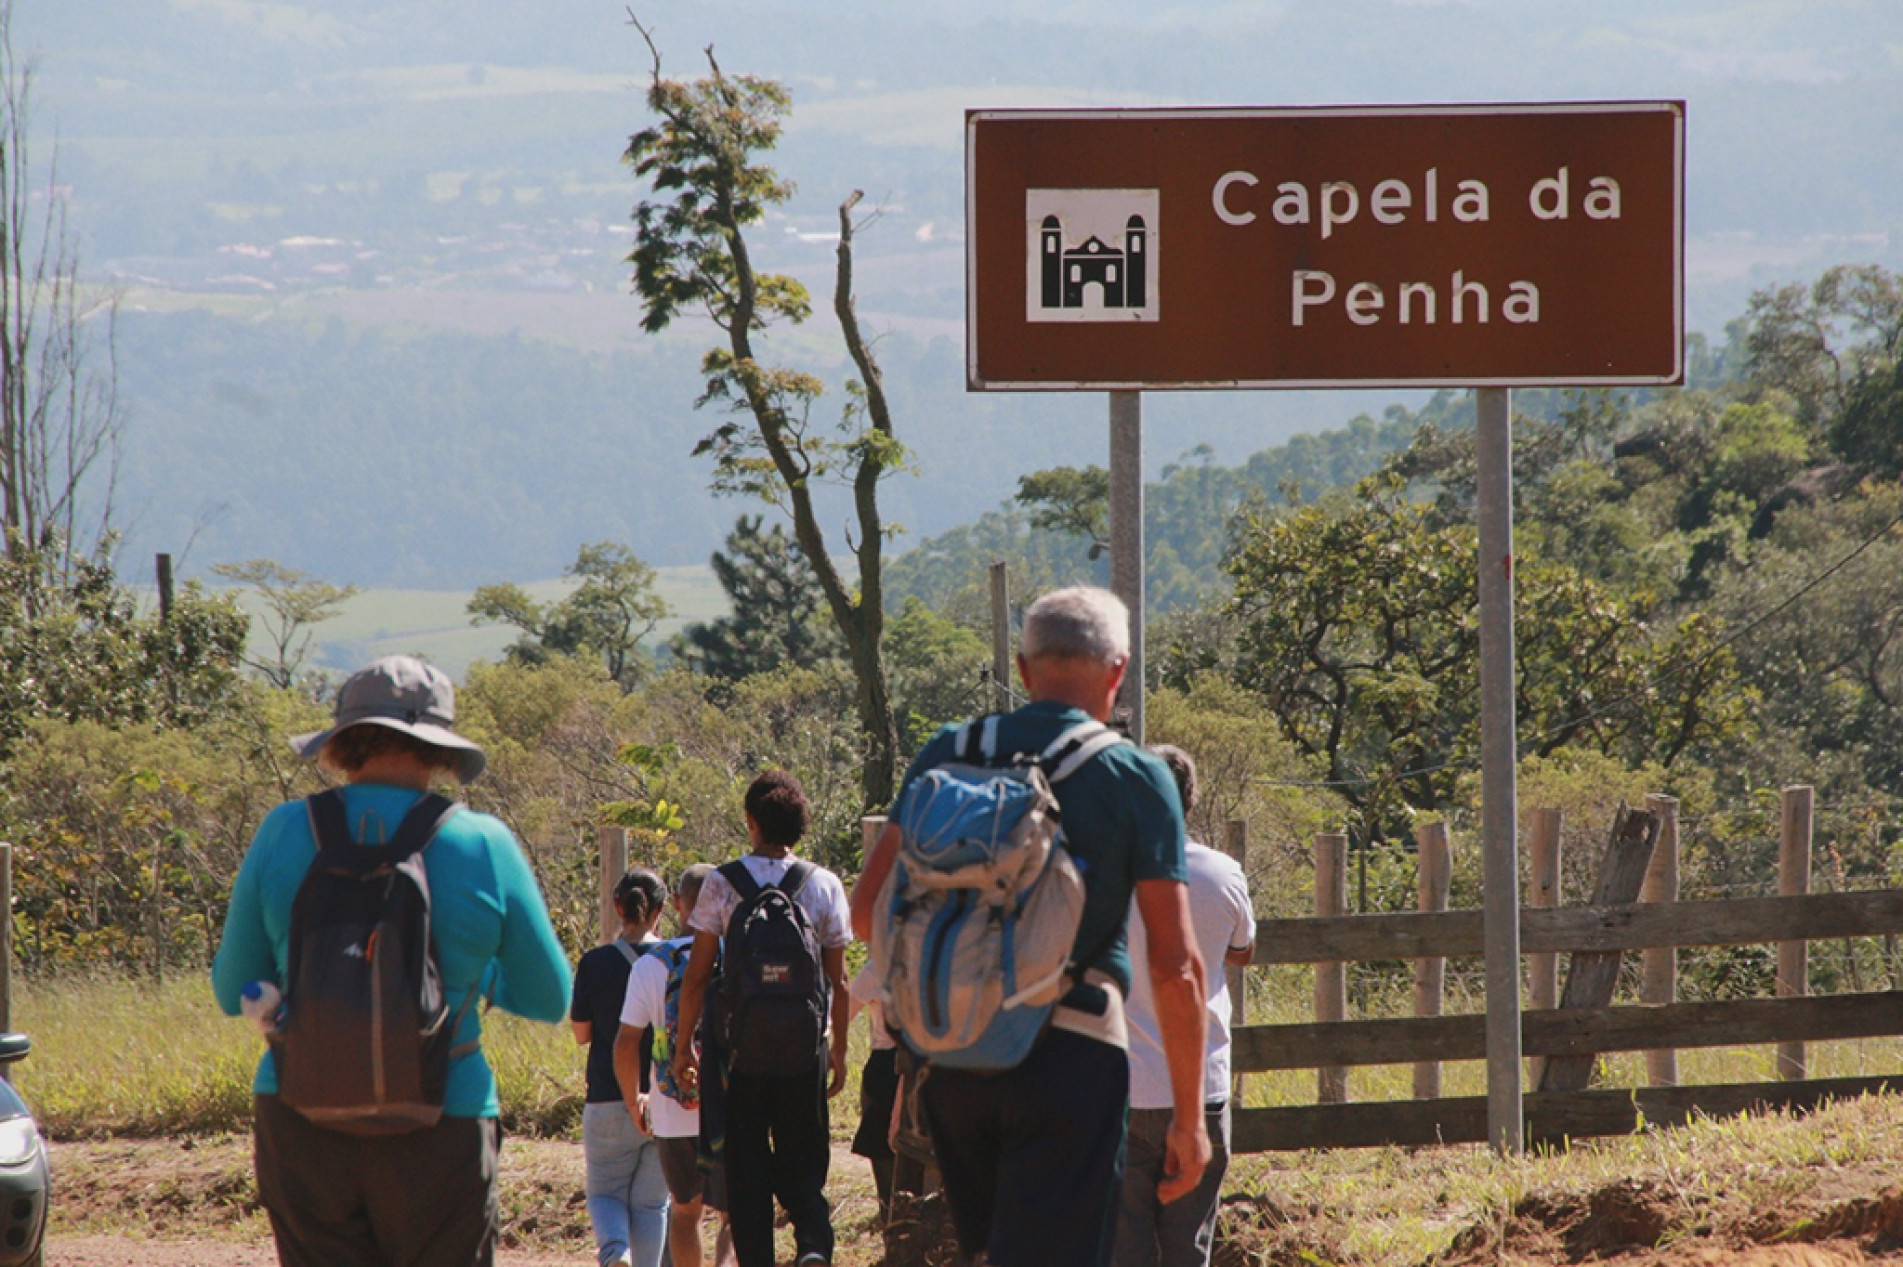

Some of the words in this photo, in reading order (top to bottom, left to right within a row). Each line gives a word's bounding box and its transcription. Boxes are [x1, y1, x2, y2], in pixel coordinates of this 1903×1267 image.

[1212, 168, 1489, 239] Capela
[1529, 166, 1620, 220] da
[1292, 270, 1539, 326] Penha
